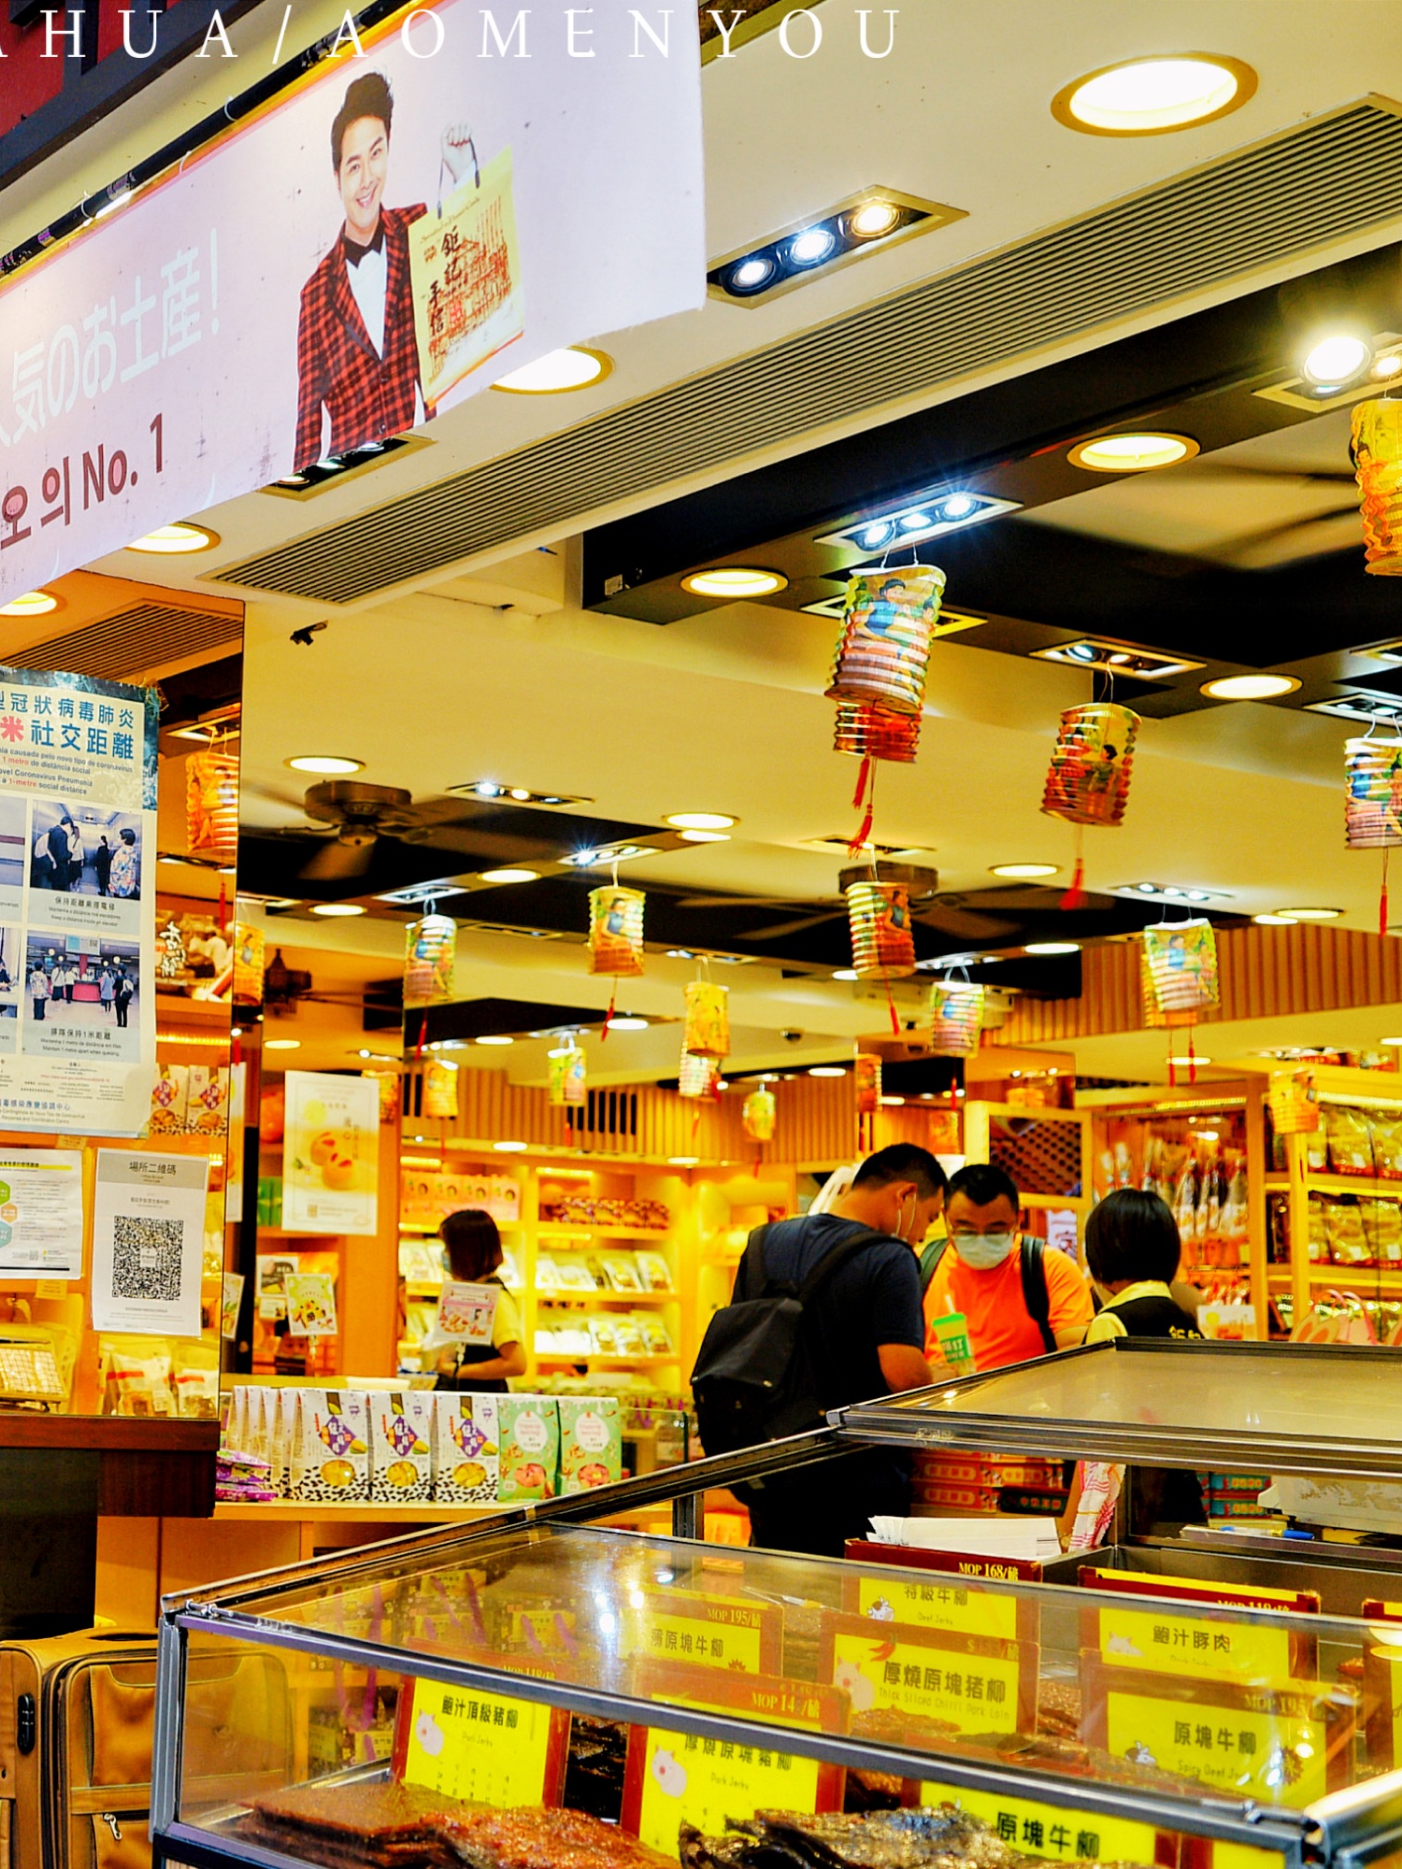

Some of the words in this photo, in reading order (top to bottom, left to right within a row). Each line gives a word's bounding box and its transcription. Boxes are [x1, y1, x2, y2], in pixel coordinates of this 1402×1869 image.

[40, 455, 71, 527] 의
[83, 443, 138, 511] No.
[150, 412, 163, 474] 1
[10, 749, 39, 758] causada
[8, 757, 29, 766] metro
[72, 765, 91, 775] social
[9, 777, 37, 788] 1-metre
[38, 780, 58, 791] social
[59, 783, 87, 795] distance
[14, 769, 56, 781] Coronavirus
[58, 774, 93, 787] Pneumonia
[129, 1160, 177, 1176] 場所二維碼
[959, 1562, 982, 1574] MOP
[707, 1608, 728, 1621] MOP
[751, 1692, 778, 1710] MOP
[780, 1693, 821, 1719] 14/磅
[1174, 1721, 1257, 1756] 原塊牛柳
